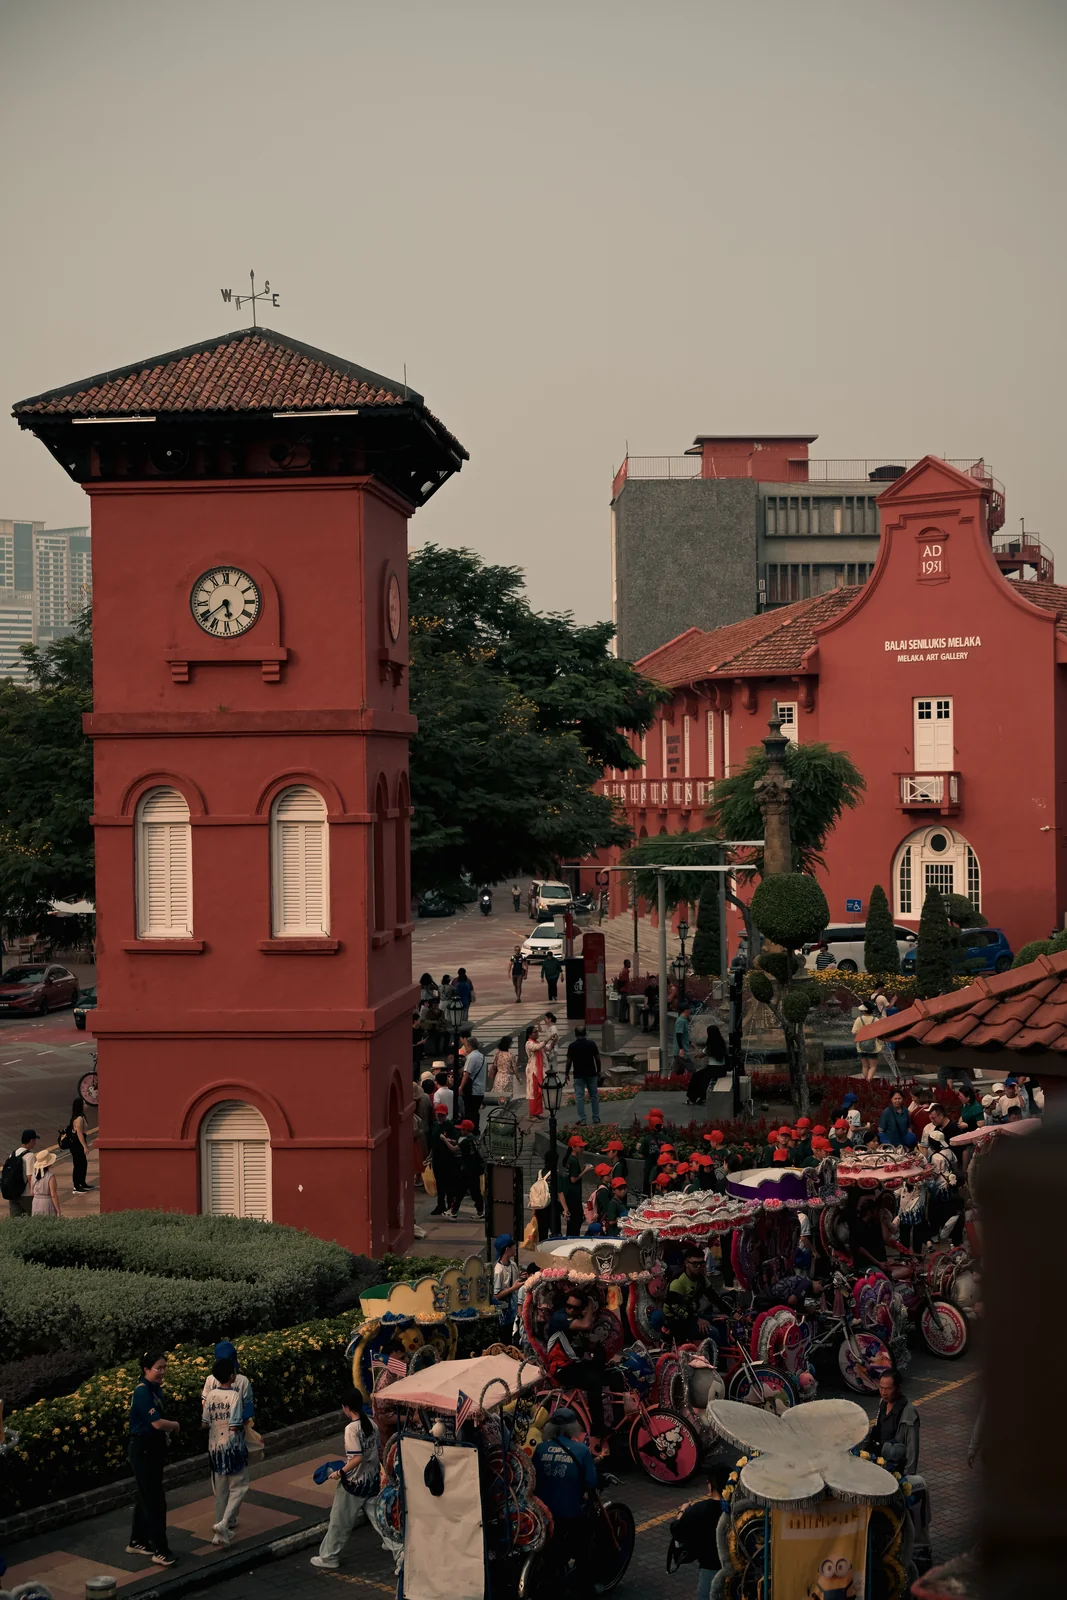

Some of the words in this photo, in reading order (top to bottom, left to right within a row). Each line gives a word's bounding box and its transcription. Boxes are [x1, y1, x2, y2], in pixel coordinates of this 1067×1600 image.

[220, 288, 232, 303] W
[272, 293, 281, 308] E
[922, 545, 942, 558] AD
[922, 560, 942, 575] 1931
[884, 640, 908, 652] BALAI
[908, 637, 947, 650] SENILUKIS
[947, 636, 982, 648] MELAKA
[897, 654, 924, 663] MELAKA
[925, 653, 939, 662] ART
[940, 652, 969, 661] GALLERY
